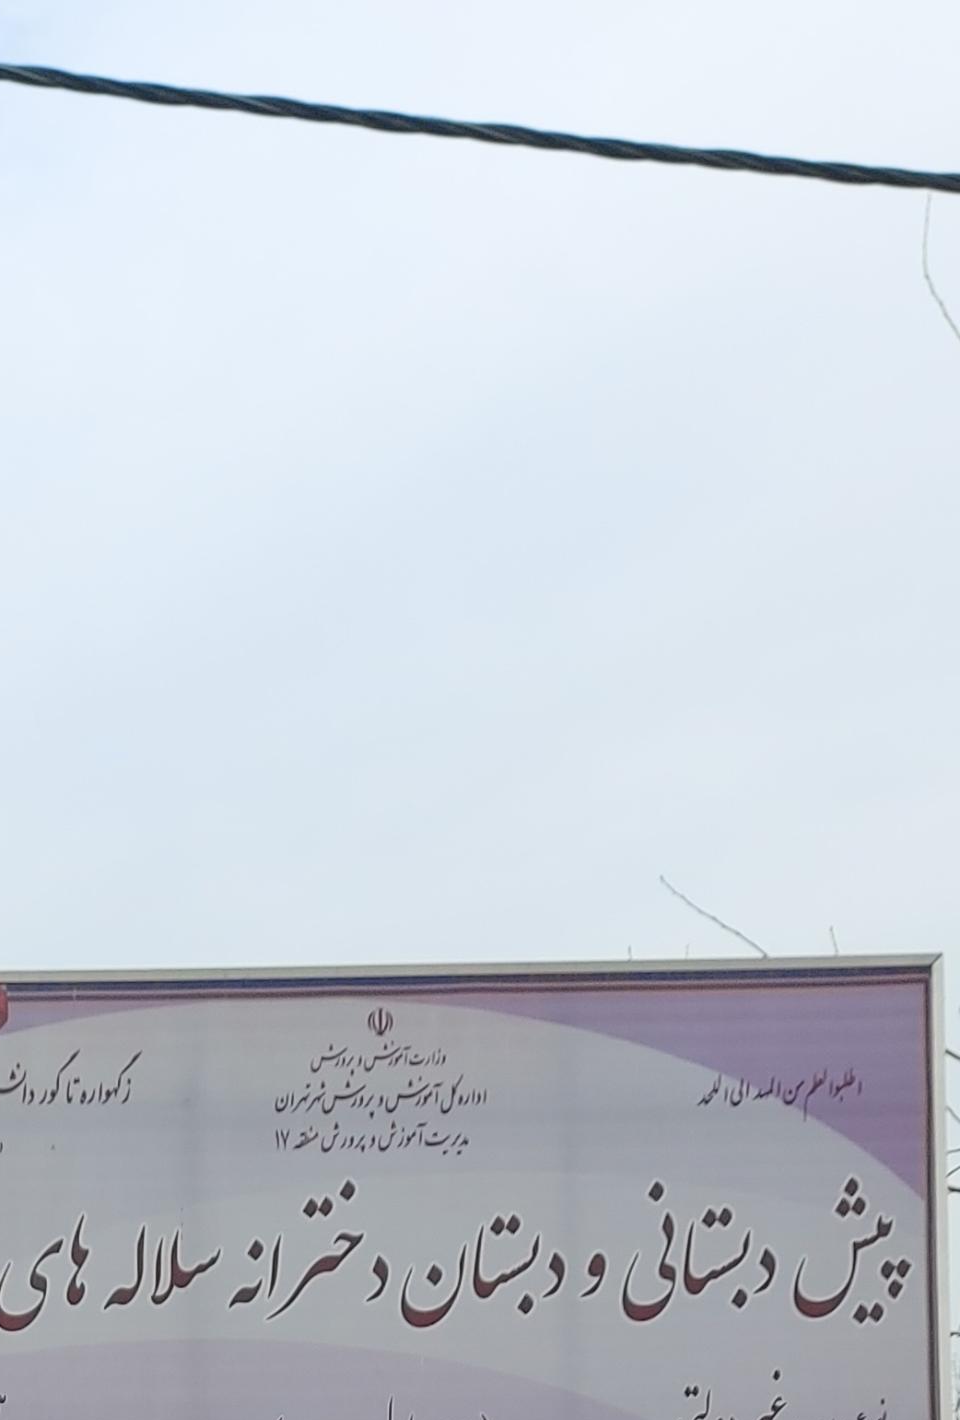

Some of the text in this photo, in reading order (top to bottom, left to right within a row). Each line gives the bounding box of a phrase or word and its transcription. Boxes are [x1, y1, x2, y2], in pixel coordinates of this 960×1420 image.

[310, 1043, 354, 1076] پرورش
[364, 1041, 411, 1071] آموزش
[409, 1049, 446, 1066] وزارت
[66, 1078, 80, 1104] تا
[322, 1080, 375, 1118] پرورش
[385, 1076, 442, 1113] آموزش
[440, 1074, 463, 1113] کل
[458, 1089, 487, 1106] اداره
[275, 1129, 290, 1150] ۱۷
[293, 1126, 318, 1149] منطقه
[321, 1122, 365, 1152] پرورش
[378, 1121, 427, 1151] آموزش
[424, 1131, 469, 1155] مدیریت
[229, 1178, 389, 1321] دخترانه
[621, 1179, 777, 1322] دبستانی
[792, 1176, 912, 1324] پیش
[103, 1224, 222, 1311] سلاله
[400, 1213, 566, 1328] دبستان
[580, 1252, 607, 1299] و
